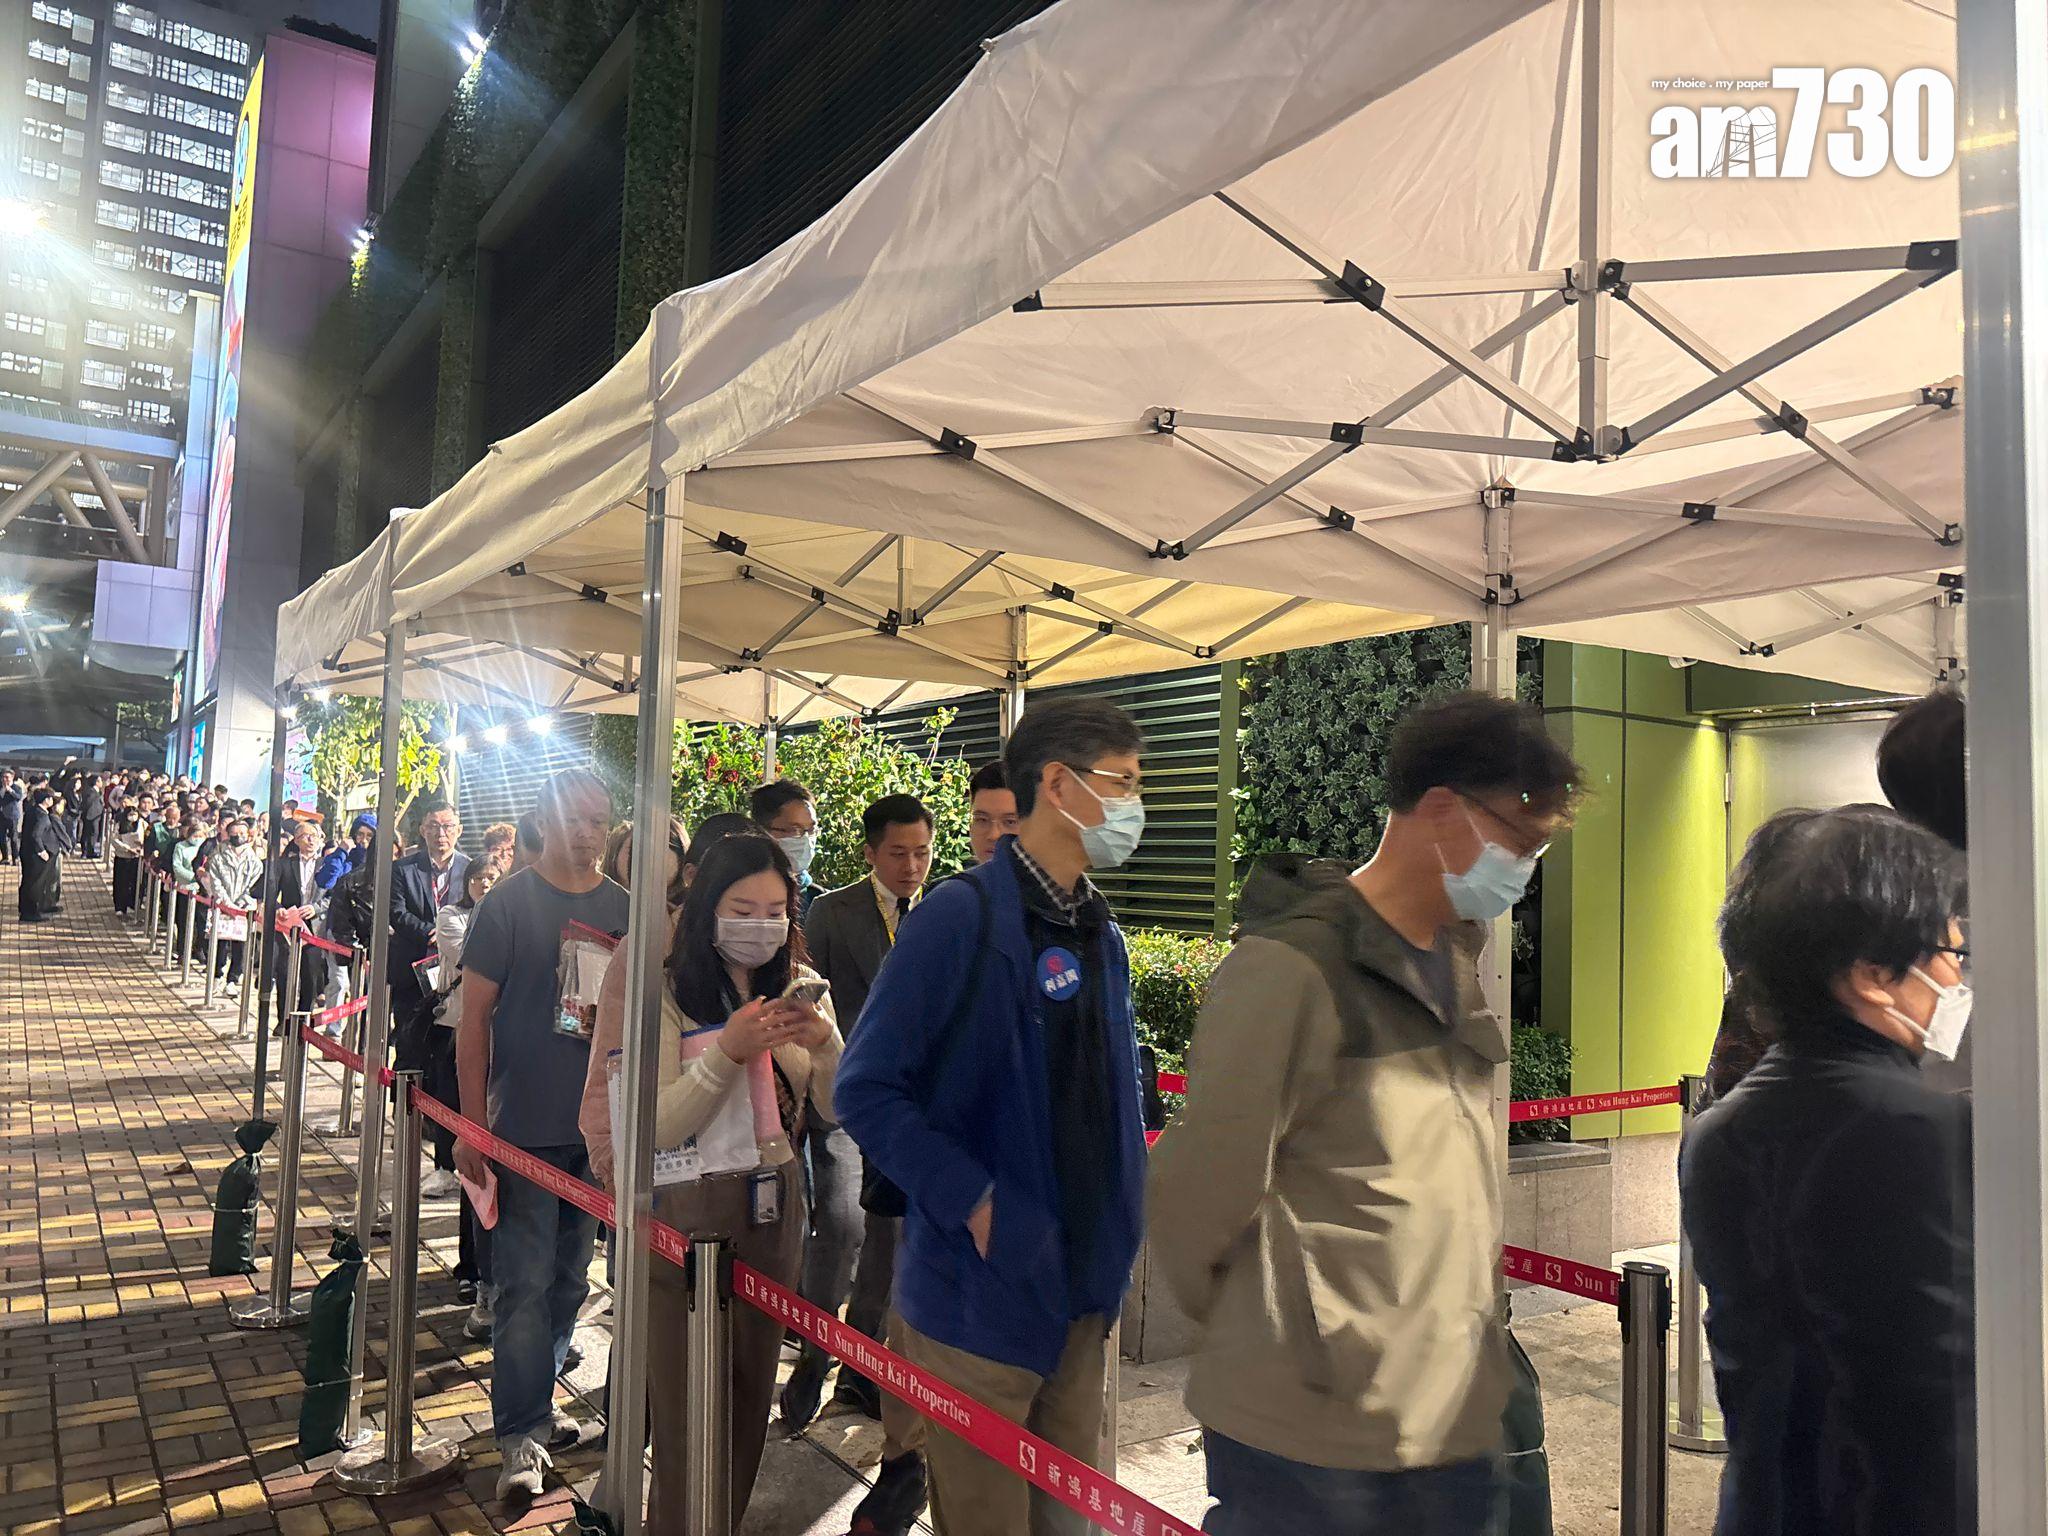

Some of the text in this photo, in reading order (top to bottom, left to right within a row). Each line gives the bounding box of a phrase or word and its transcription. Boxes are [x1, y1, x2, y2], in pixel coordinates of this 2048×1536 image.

[1574, 1271, 1604, 1293] Sun
[834, 1329, 853, 1358] Sun
[856, 1342, 884, 1381] Hung
[887, 1360, 906, 1389] Kai
[909, 1373, 971, 1429] Properties
